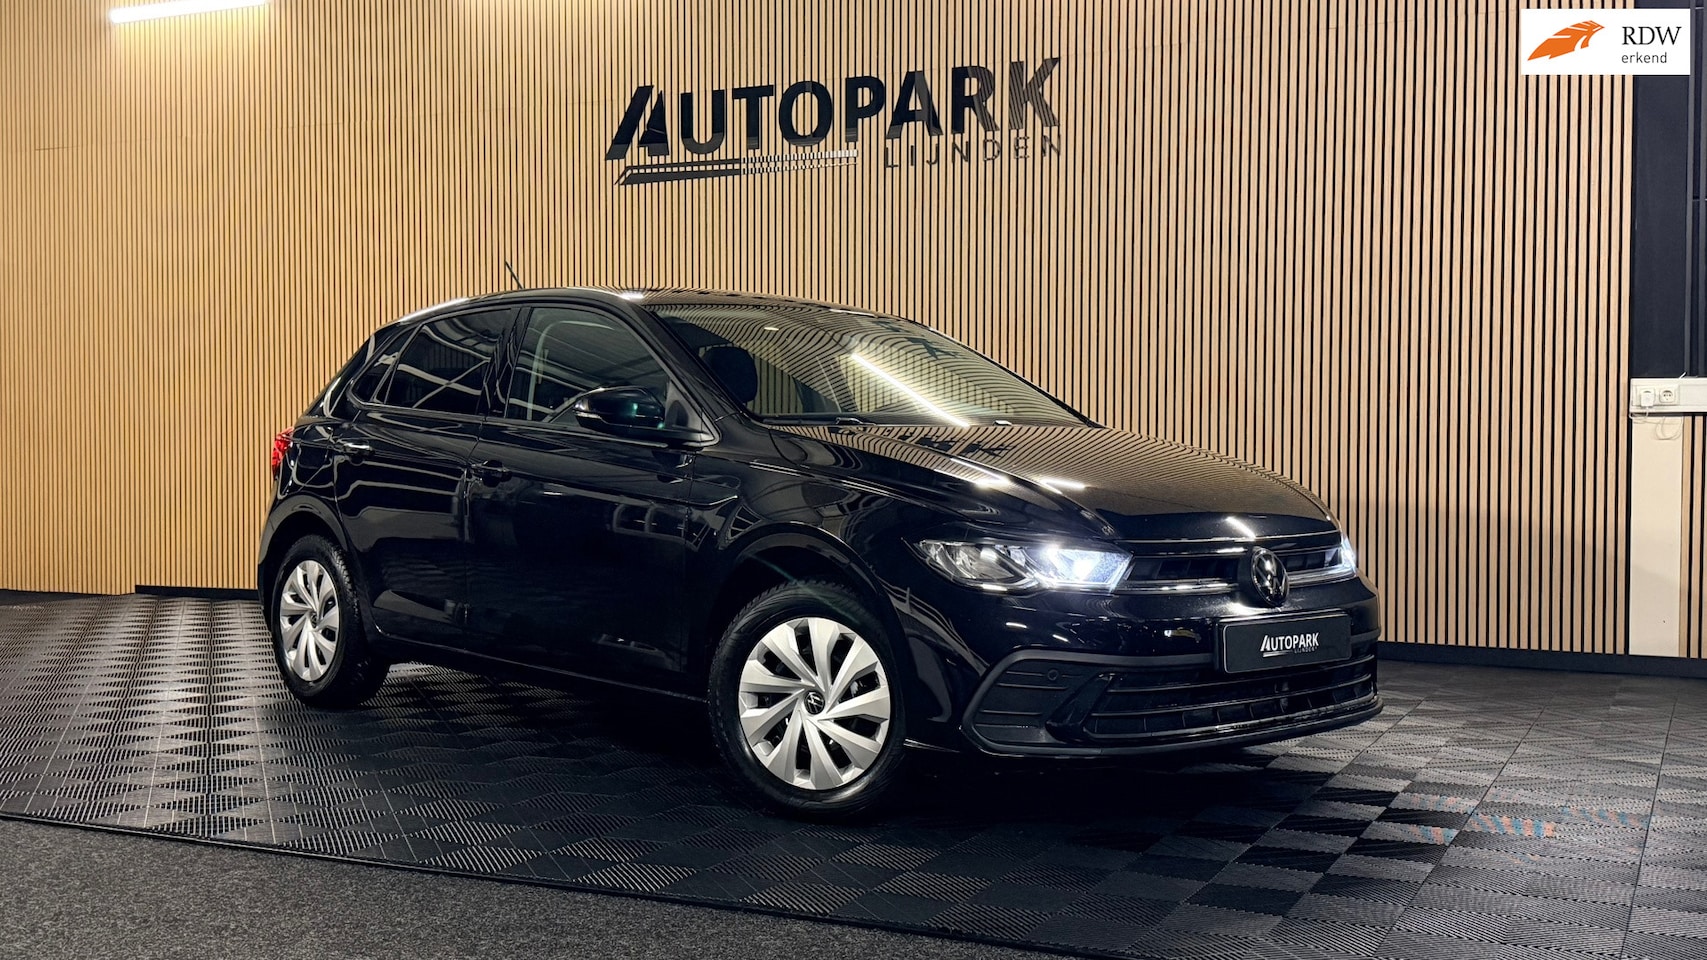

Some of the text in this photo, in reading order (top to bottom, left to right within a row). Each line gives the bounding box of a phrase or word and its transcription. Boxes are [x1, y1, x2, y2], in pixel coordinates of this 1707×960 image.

[605, 57, 1060, 161] AUTOPARK
[885, 133, 1061, 168] LIJNDEN
[1260, 632, 1319, 652] AUTOPARK
